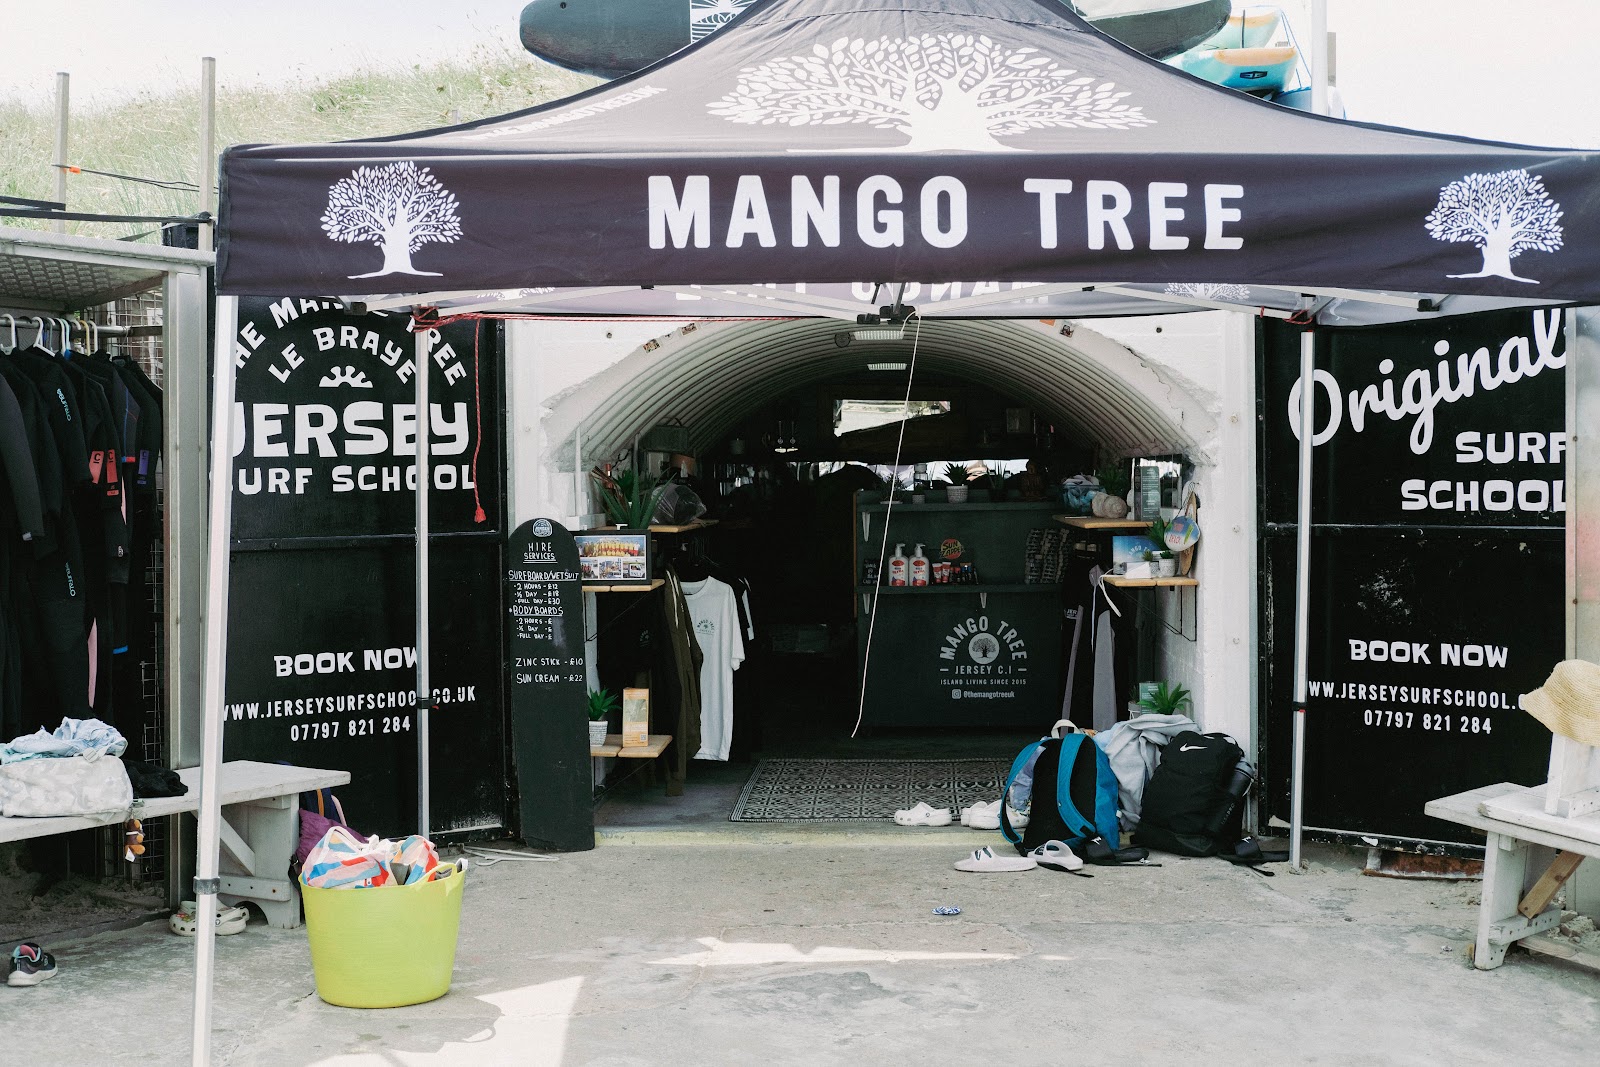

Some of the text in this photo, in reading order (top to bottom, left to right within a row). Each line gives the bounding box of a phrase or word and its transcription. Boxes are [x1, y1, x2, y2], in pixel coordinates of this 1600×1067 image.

[648, 174, 1244, 250] MANGO TREE
[268, 325, 416, 384] LE BRAYE
[1286, 308, 1567, 456] Original
[1455, 431, 1566, 464] SURF
[231, 467, 312, 495] URF
[1401, 479, 1566, 512] SCHOOL
[524, 552, 556, 560] SERVICES
[528, 542, 552, 552] HIRE
[512, 605, 564, 616] BODYBOARDS
[940, 616, 1028, 660] MANGO TREE
[274, 646, 417, 677] BOOK NOW
[516, 658, 538, 666] ZINC
[1349, 639, 1508, 668] BOOK NOW
[516, 673, 532, 684] SUN
[534, 674, 560, 682] CREAM
[955, 666, 1012, 674] JERSEY C.I
[290, 716, 410, 742] 07797 821 284
[1364, 709, 1492, 734] 07797 821 284
